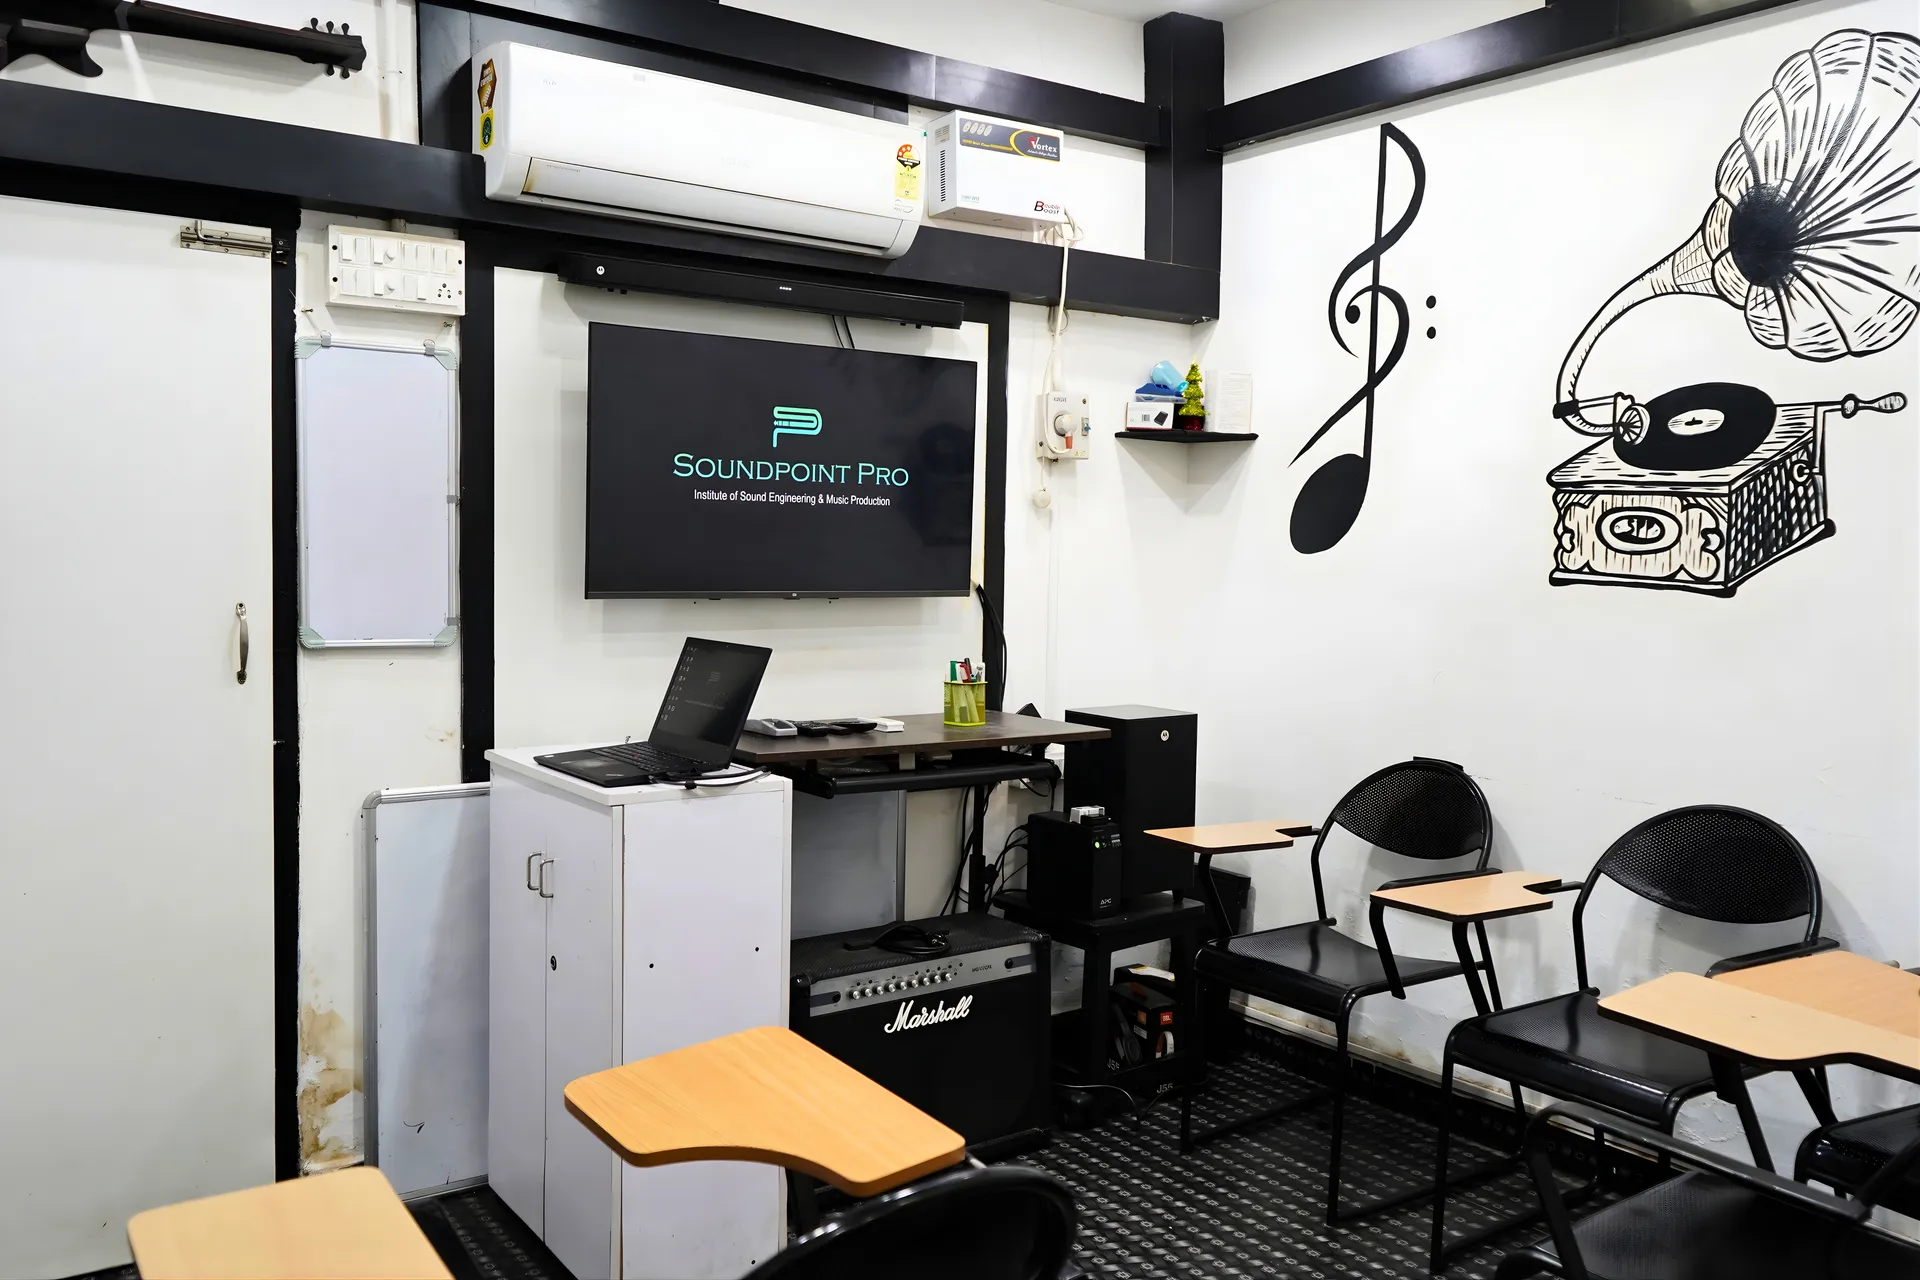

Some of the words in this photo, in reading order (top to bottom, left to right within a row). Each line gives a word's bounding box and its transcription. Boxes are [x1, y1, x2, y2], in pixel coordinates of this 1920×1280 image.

[1030, 136, 1058, 153] Vortex
[672, 452, 851, 484] SOUNDPOINT
[857, 462, 910, 487] PRO
[694, 489, 728, 501] Institute
[729, 490, 740, 501] of
[740, 491, 767, 503] Sound
[769, 492, 816, 506] Engineering
[818, 494, 825, 504] &
[826, 494, 850, 505] Music
[850, 495, 891, 506] Production
[1099, 897, 1112, 905] APC
[884, 995, 973, 1033] Marshall
